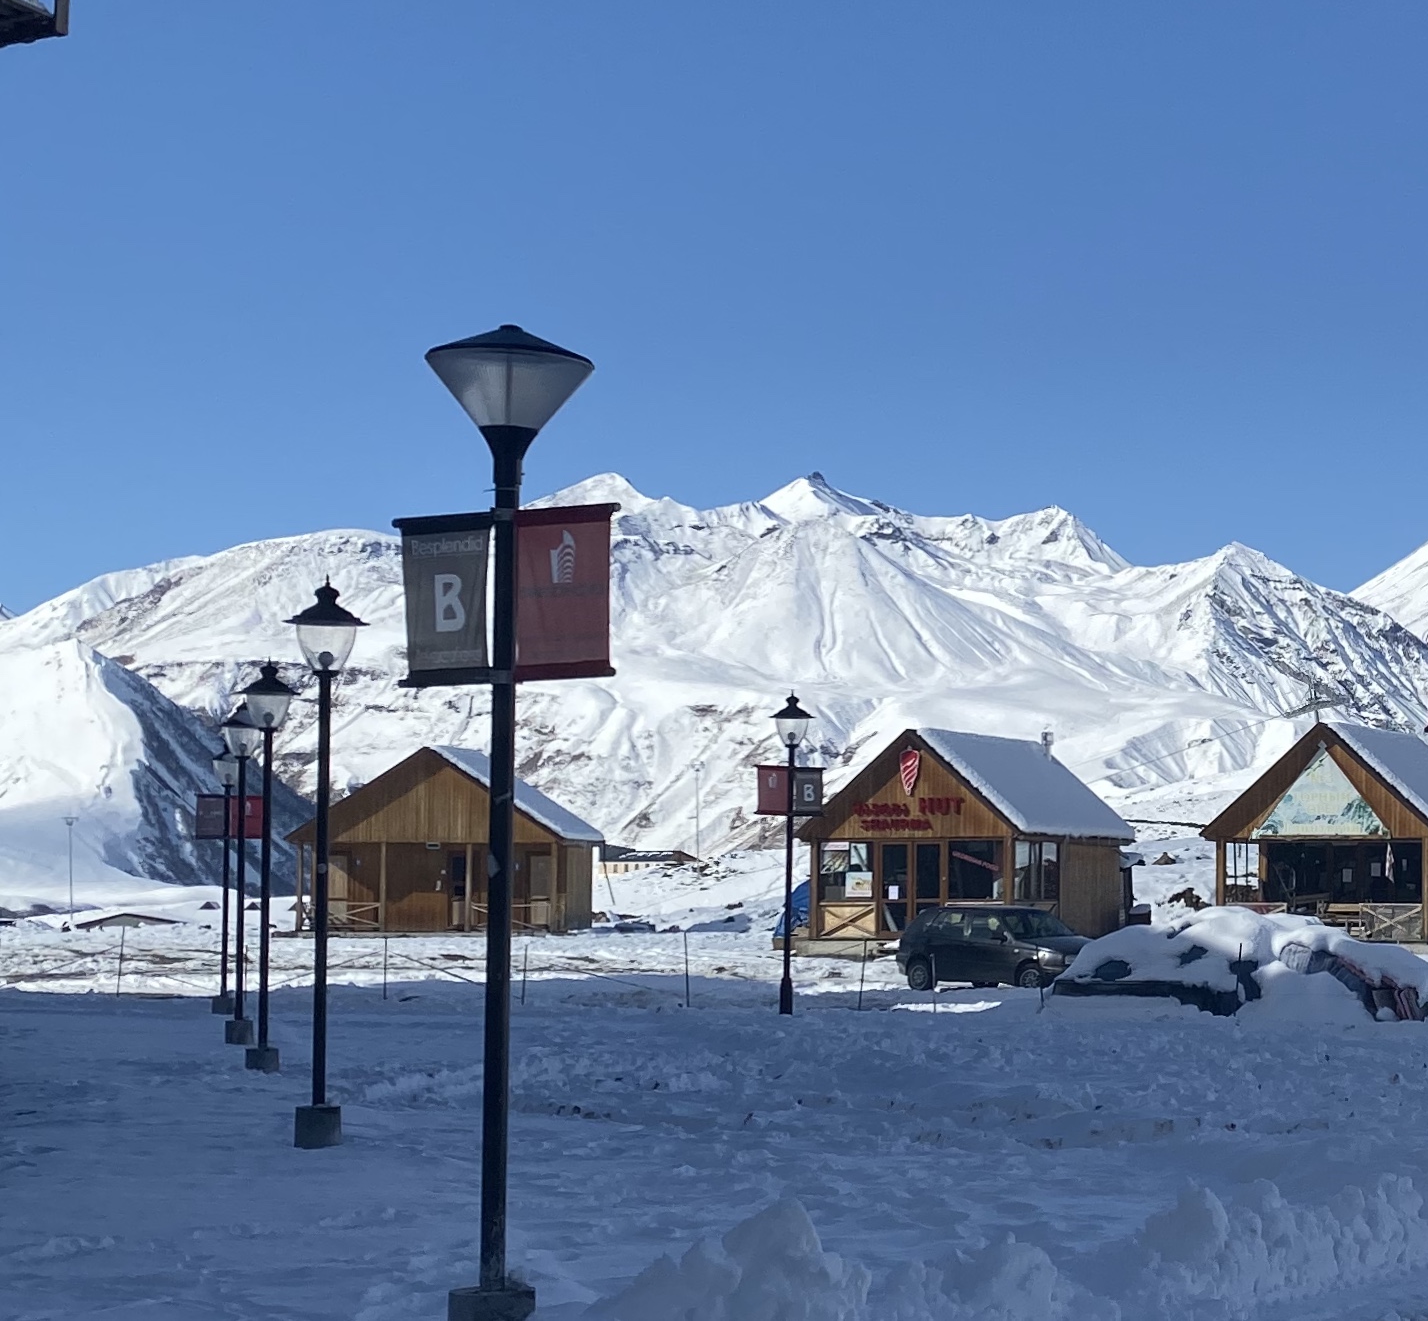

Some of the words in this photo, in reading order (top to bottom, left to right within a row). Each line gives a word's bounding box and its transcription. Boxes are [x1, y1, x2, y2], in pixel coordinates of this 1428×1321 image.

[434, 573, 466, 632] B
[803, 783, 815, 802] B
[918, 796, 965, 815] HUT
